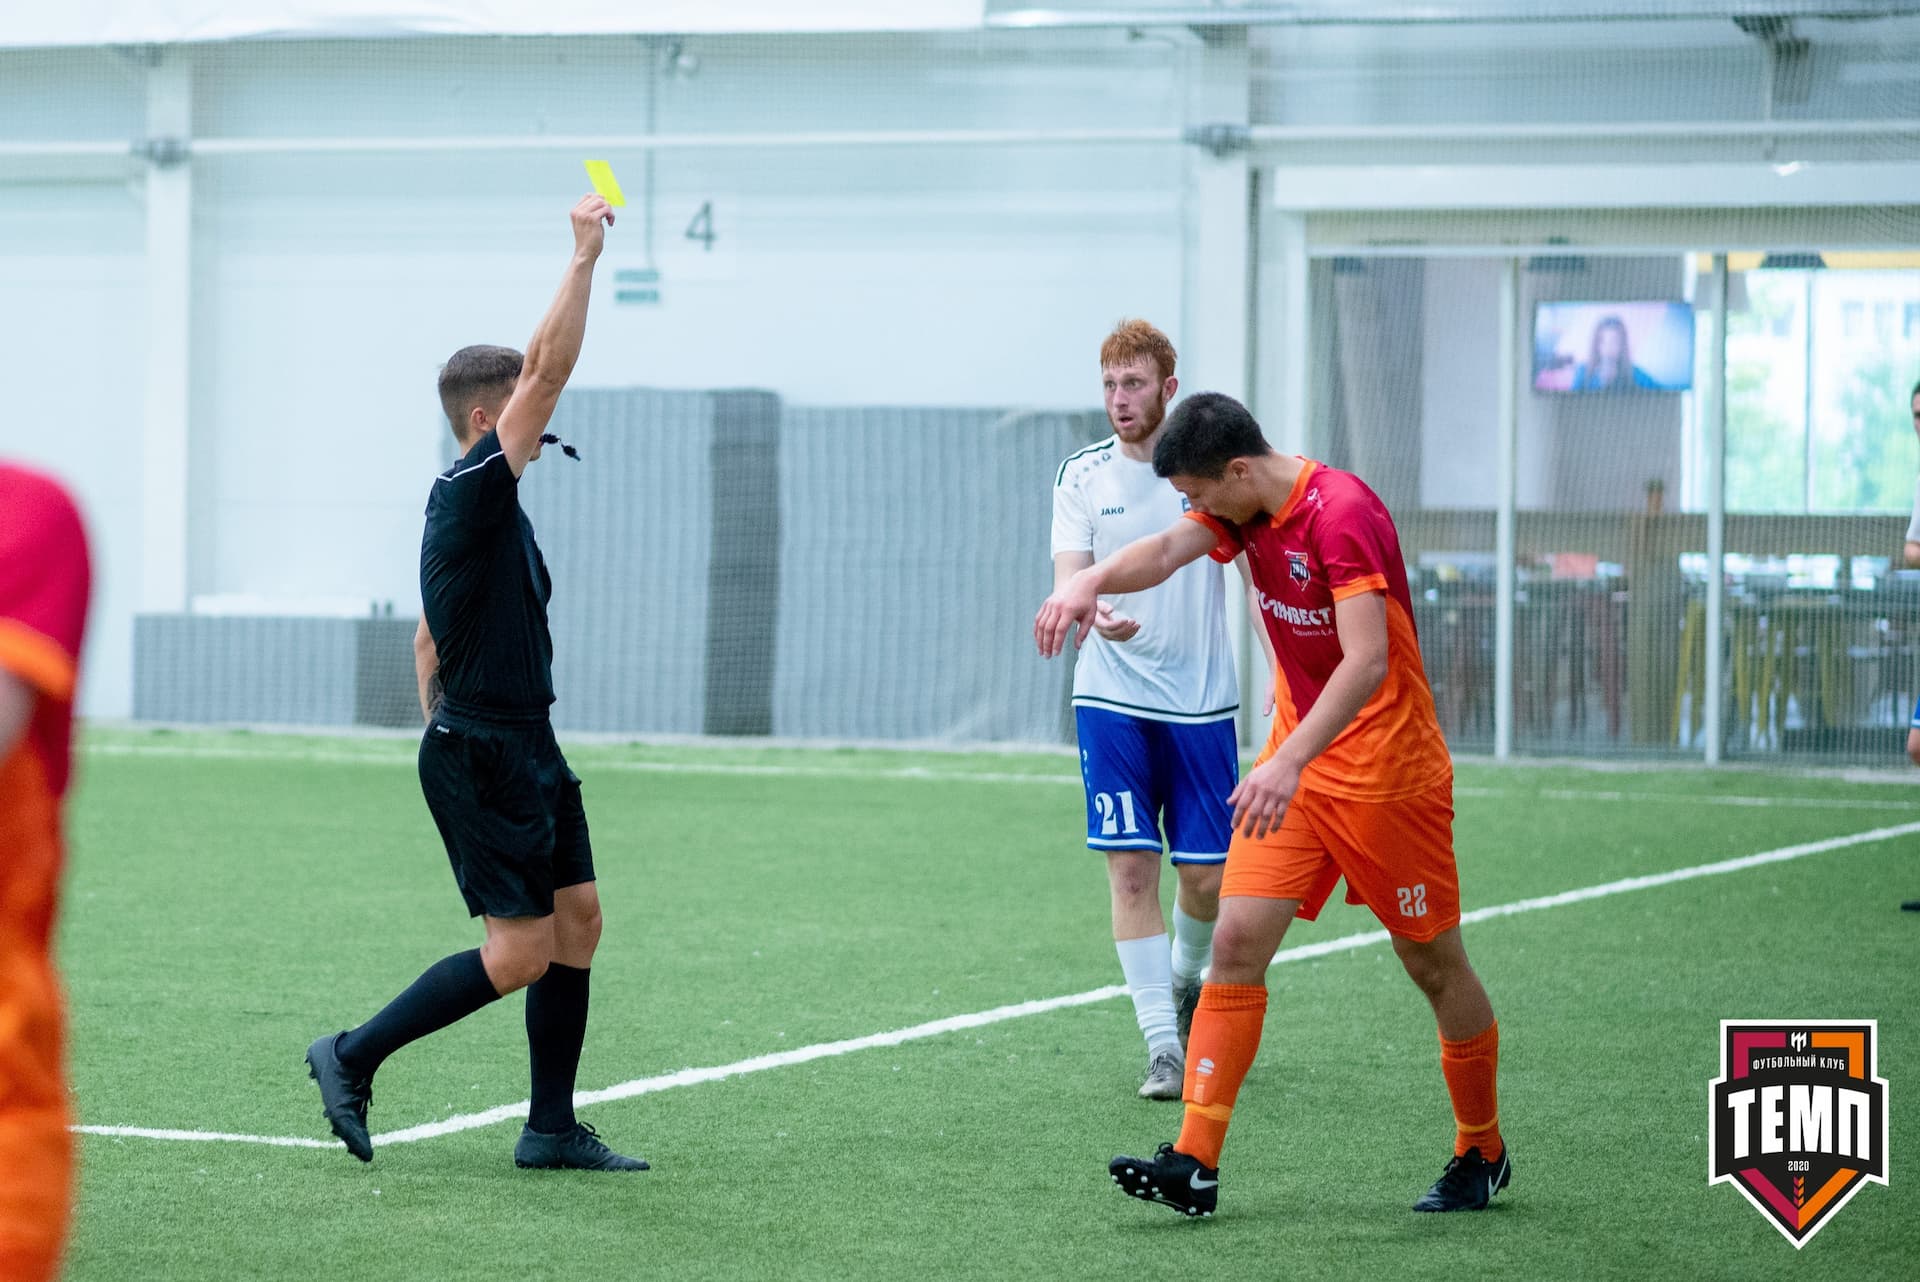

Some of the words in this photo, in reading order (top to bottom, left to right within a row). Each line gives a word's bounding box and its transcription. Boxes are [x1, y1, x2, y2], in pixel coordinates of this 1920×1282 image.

[686, 202, 717, 251] 4
[1101, 507, 1125, 516] JAKO
[1095, 790, 1139, 835] 21
[1397, 884, 1427, 917] 22
